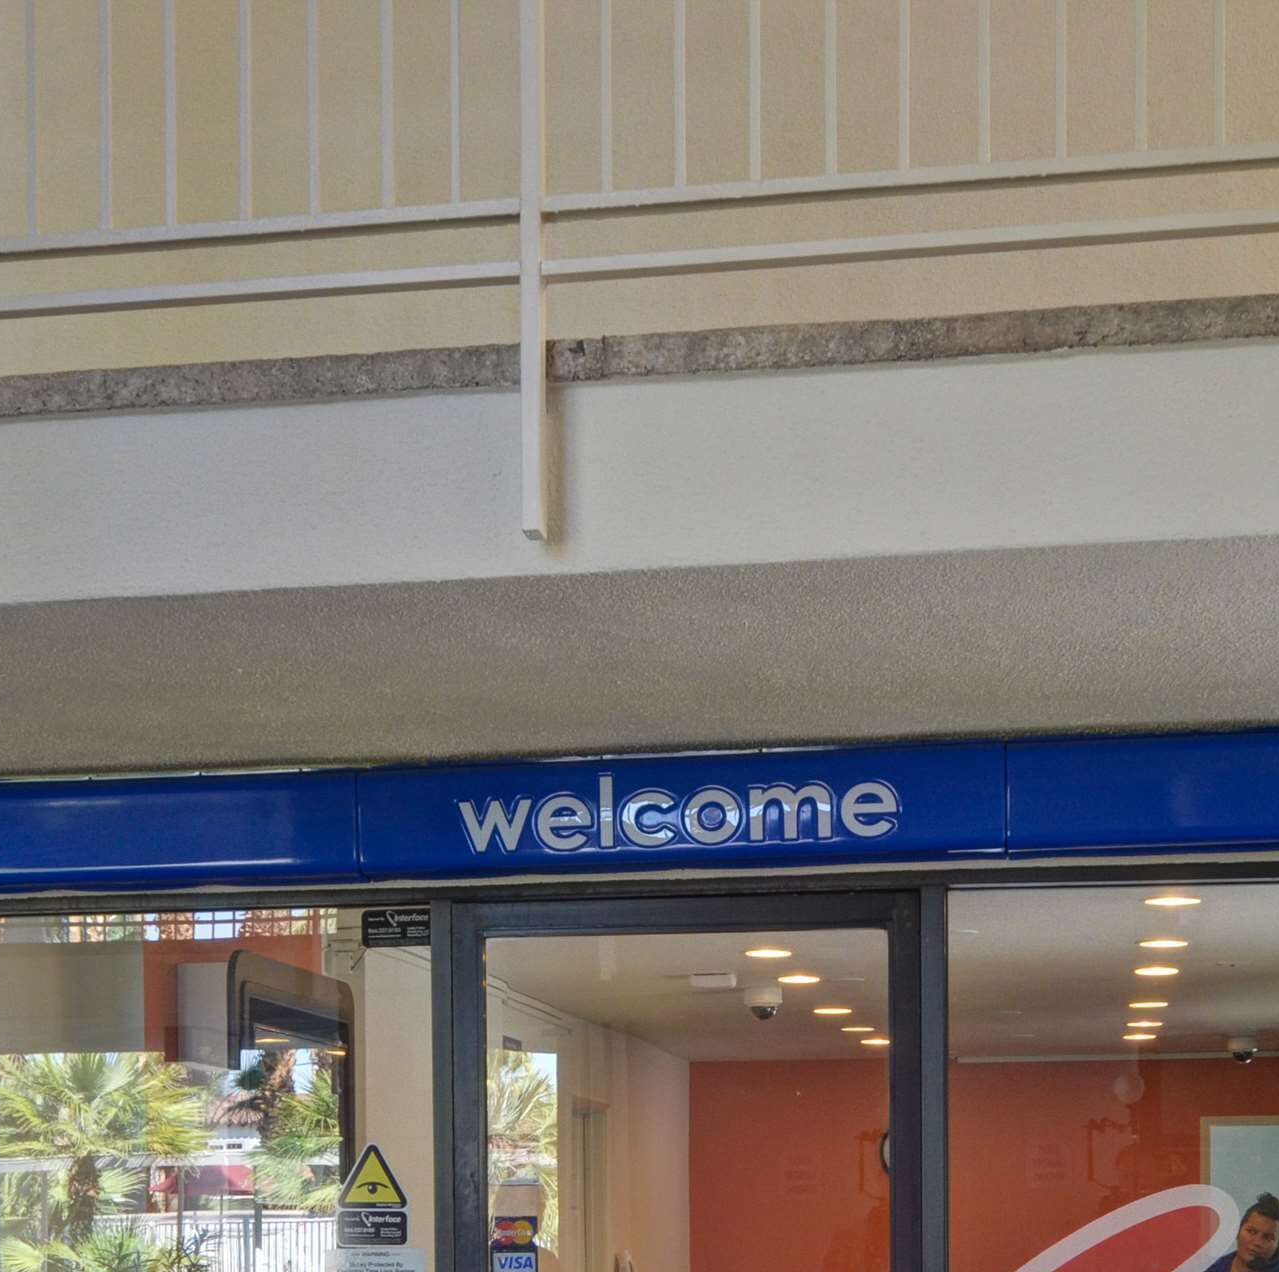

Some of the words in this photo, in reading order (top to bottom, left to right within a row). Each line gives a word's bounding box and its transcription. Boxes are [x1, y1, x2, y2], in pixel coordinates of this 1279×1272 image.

[458, 772, 900, 854] welcome
[369, 1214, 401, 1223] Interface
[497, 1256, 534, 1270] VISA
